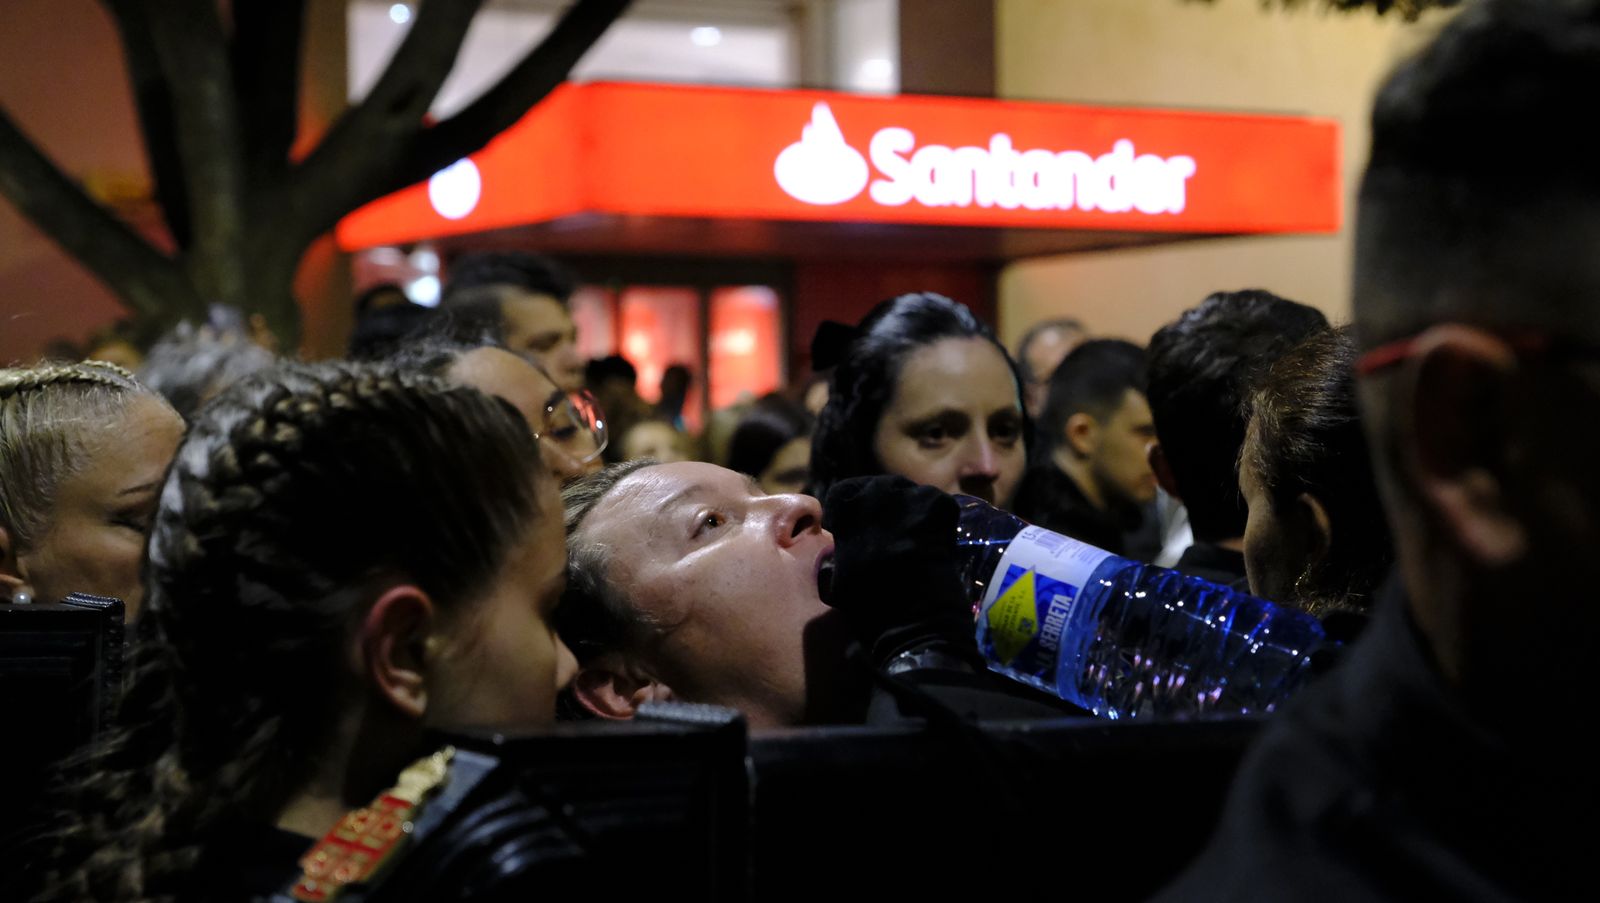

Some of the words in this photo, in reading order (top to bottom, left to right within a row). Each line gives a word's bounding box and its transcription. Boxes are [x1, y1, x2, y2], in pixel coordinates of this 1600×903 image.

[869, 127, 1196, 214] Santander
[1039, 593, 1074, 652] SERRETA
[1035, 649, 1055, 668] LA
